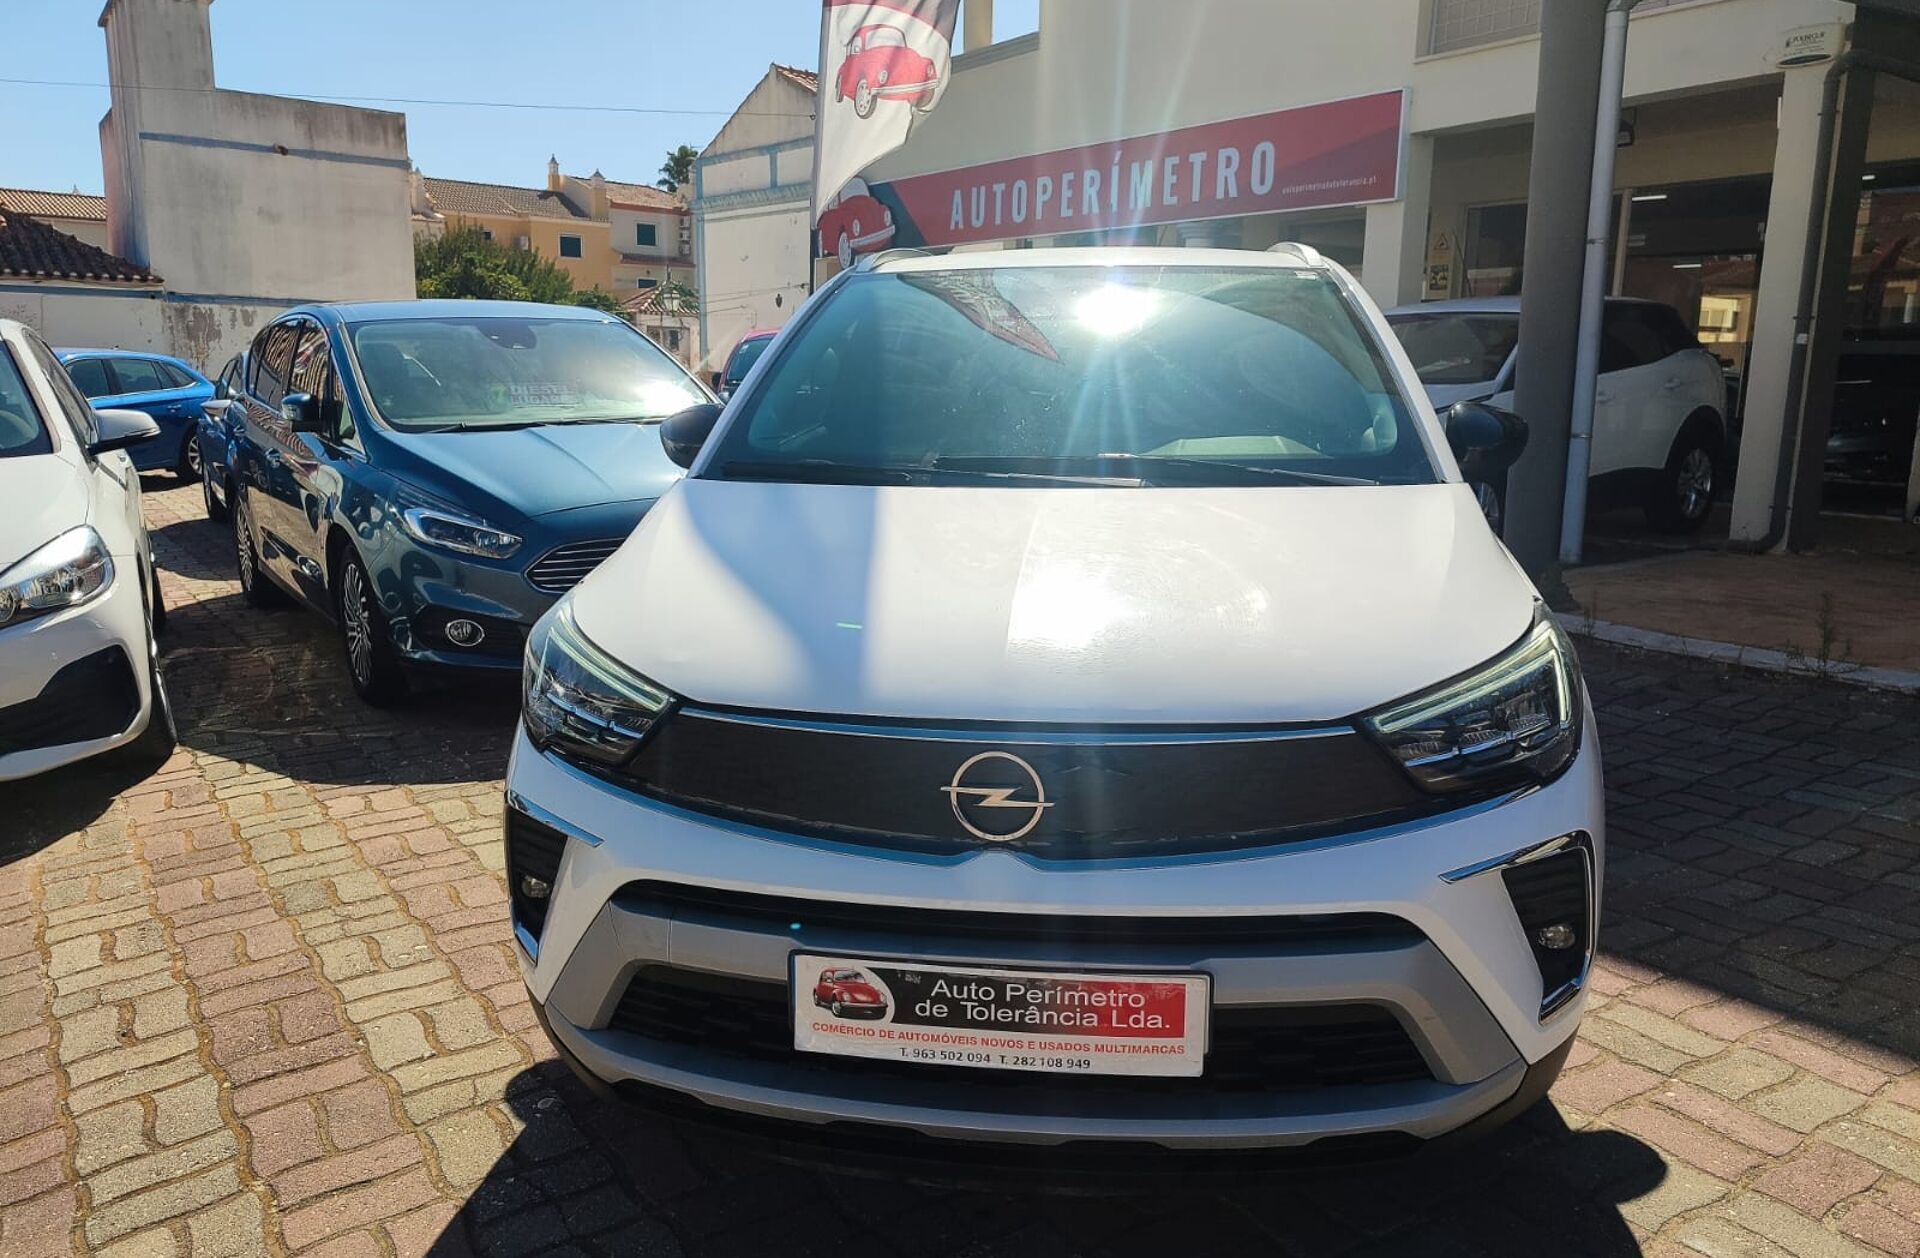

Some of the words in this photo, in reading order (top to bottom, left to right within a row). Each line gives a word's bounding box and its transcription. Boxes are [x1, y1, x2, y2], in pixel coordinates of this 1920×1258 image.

[950, 141, 1276, 231] AUTOPERÍMETRO
[931, 979, 995, 1001] Auto
[1006, 983, 1146, 1008] Perímetro
[915, 999, 949, 1018] de
[960, 1001, 1098, 1026] Tolerância
[1111, 1009, 1171, 1029] Lda.
[879, 1030, 895, 1039] DE
[898, 1031, 978, 1046] AUTOMÓVEIS
[981, 1038, 1024, 1049] NOVOS
[1027, 1040, 1036, 1050] E
[1039, 1041, 1091, 1052] USADOS
[1094, 1044, 1185, 1055] MULTIMARCAS
[899, 1047, 908, 1057] T.
[912, 1048, 936, 1059] 963
[940, 1051, 963, 1062] 502
[967, 1053, 991, 1063] 094
[1013, 1055, 1036, 1066] 282
[1040, 1057, 1062, 1068] 108
[1066, 1058, 1090, 1069] 949
